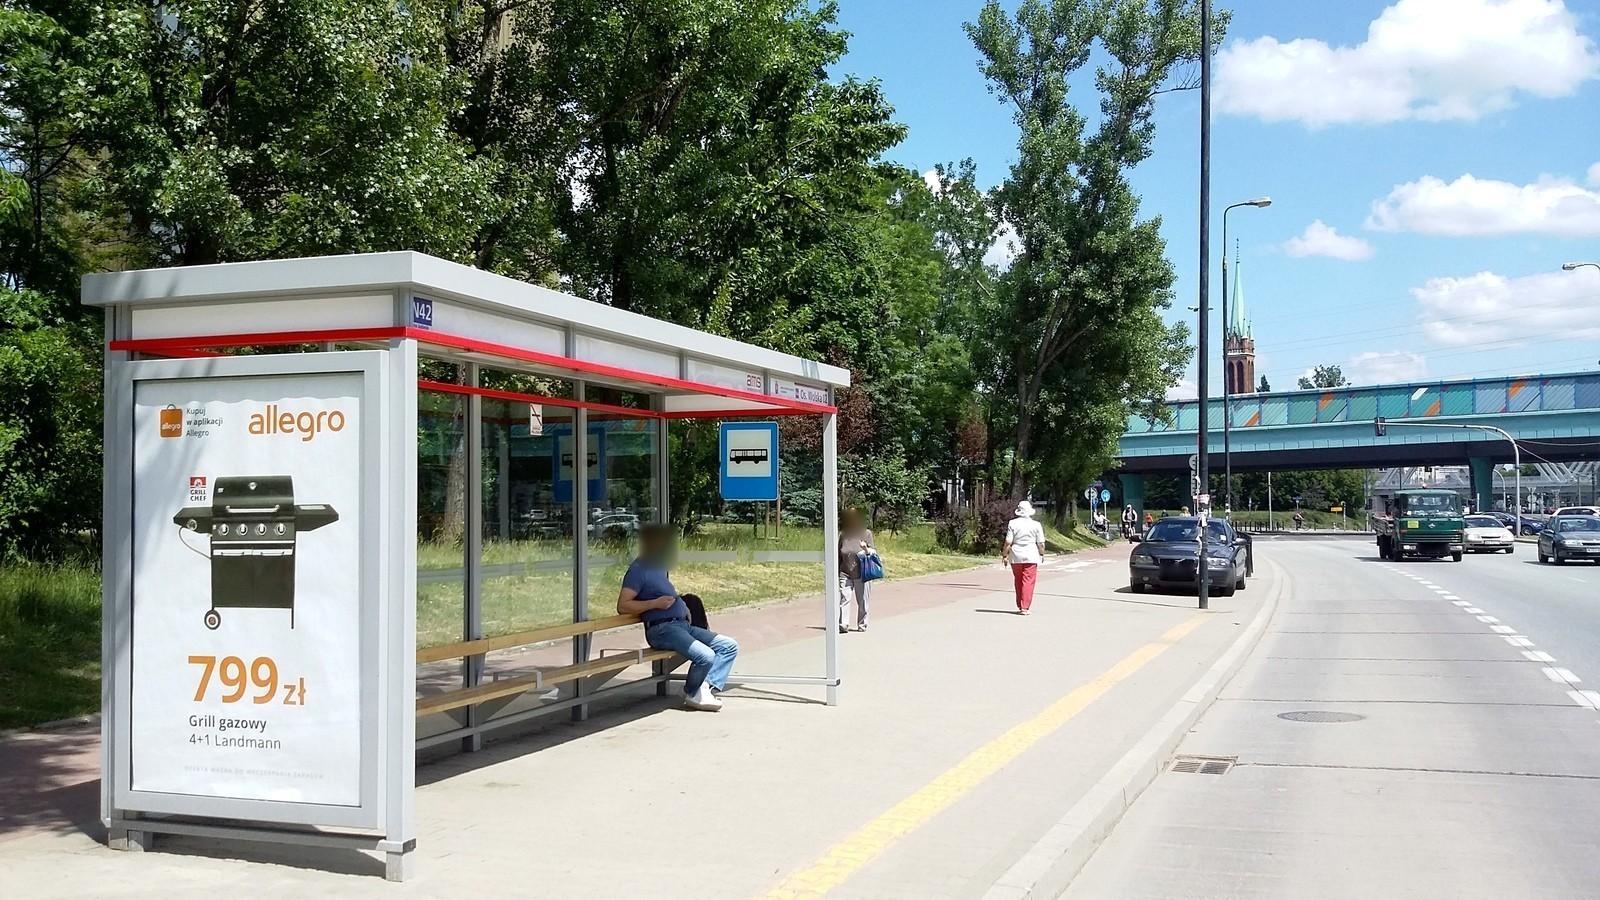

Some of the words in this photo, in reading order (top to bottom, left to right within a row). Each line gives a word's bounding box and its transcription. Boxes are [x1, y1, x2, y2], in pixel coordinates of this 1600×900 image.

[747, 374, 761, 388] ams
[186, 408, 206, 417] Kupuj
[193, 417, 223, 427] aplikacji
[248, 404, 345, 442] allegro
[186, 429, 210, 438] Allegro
[188, 655, 279, 704] 799
[283, 677, 307, 706] zł
[188, 715, 215, 727] Grill
[219, 717, 267, 733] gazowy
[189, 733, 210, 746] 4+1
[215, 735, 281, 749] Landmann
